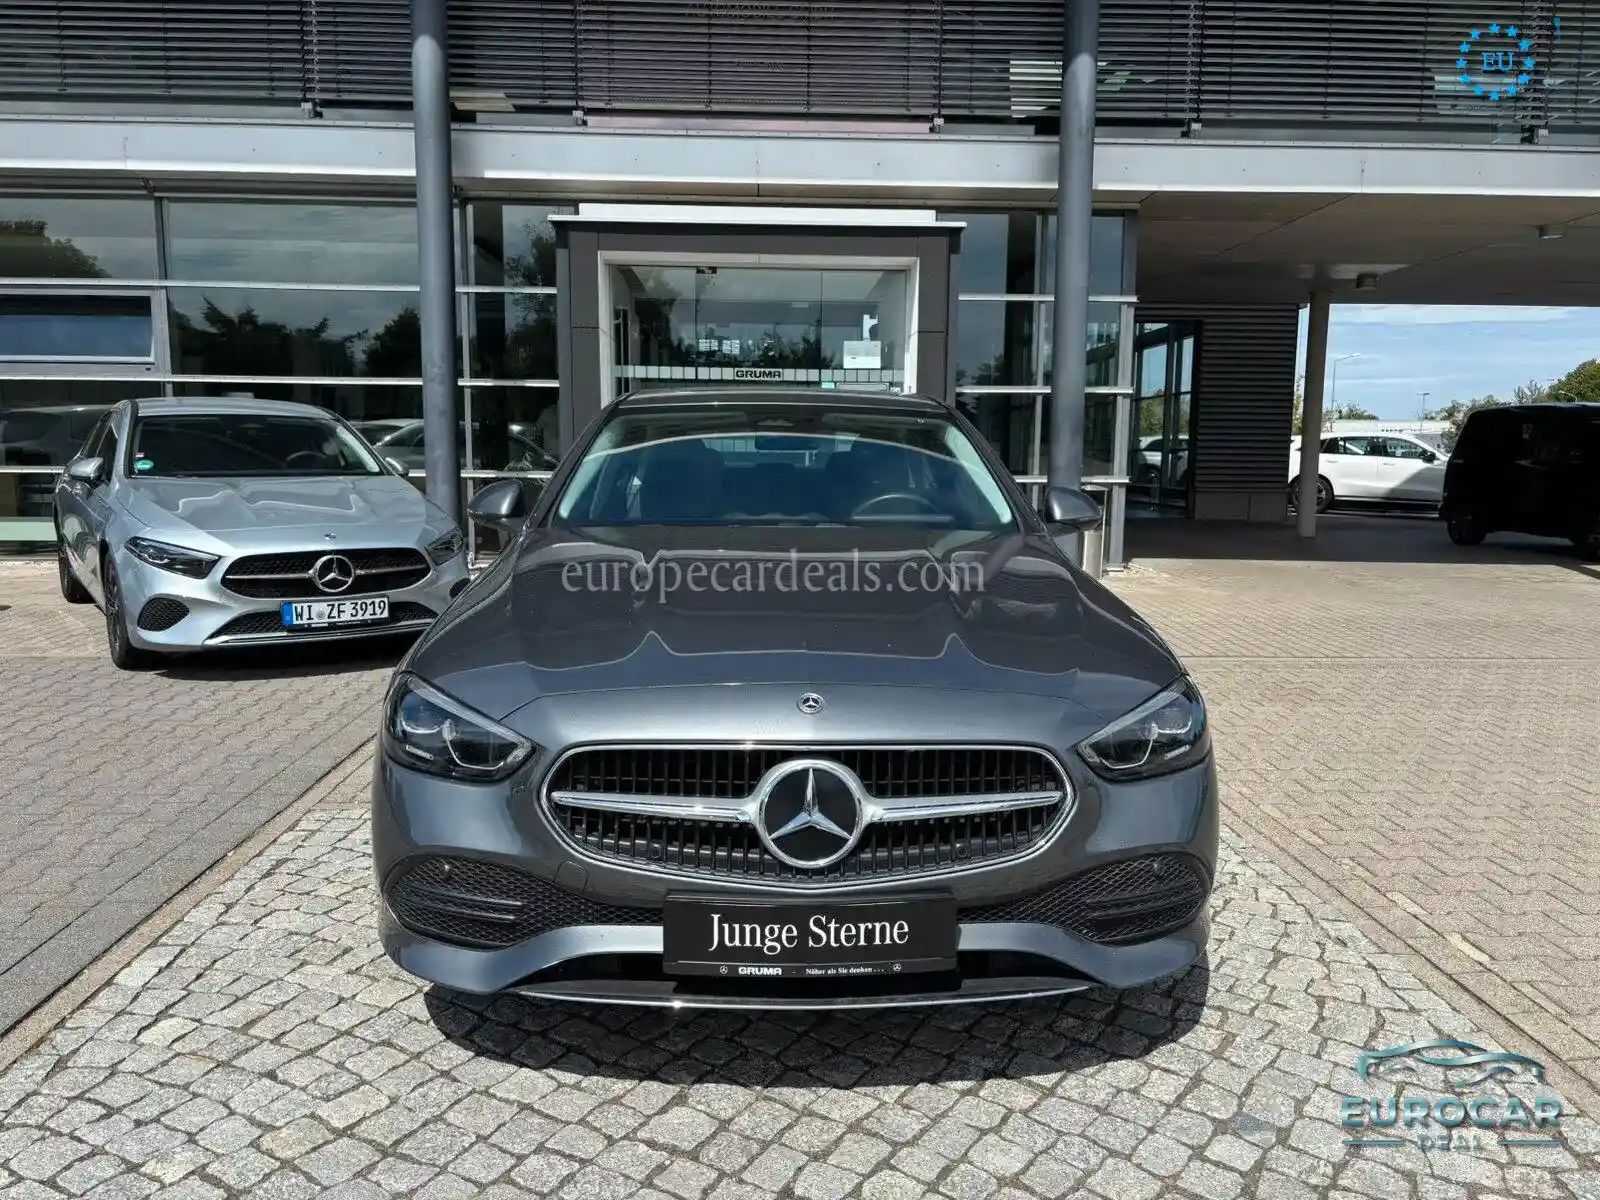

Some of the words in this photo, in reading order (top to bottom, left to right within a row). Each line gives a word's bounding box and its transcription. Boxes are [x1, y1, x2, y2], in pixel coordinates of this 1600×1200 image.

[736, 370, 781, 378] GRUMA
[294, 604, 314, 621] WI
[326, 603, 346, 619] ZF
[350, 600, 386, 618] 3919
[708, 914, 798, 955] Junge
[808, 915, 909, 948] Sterne
[738, 966, 782, 976] GRUMA
